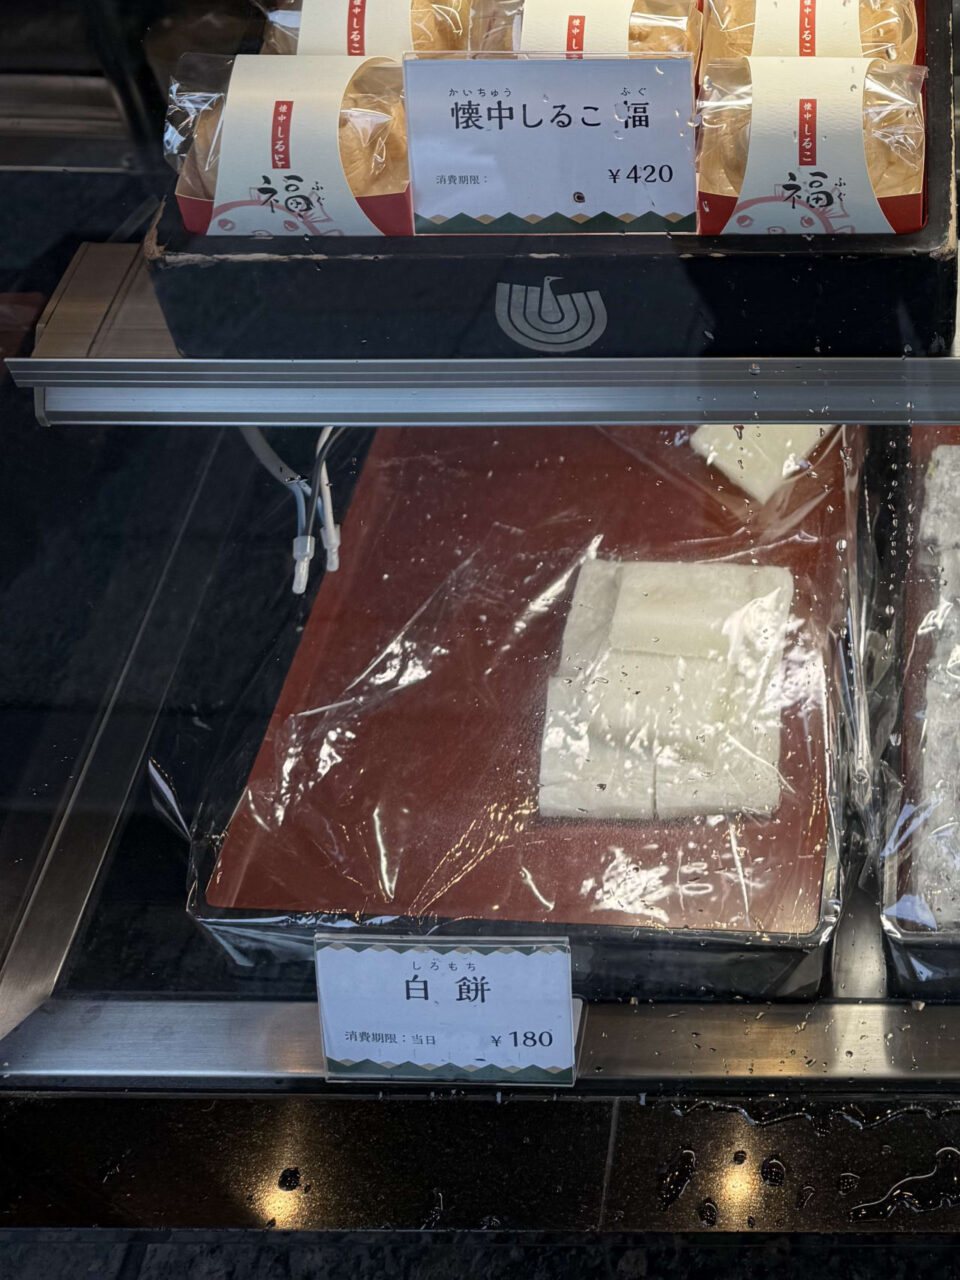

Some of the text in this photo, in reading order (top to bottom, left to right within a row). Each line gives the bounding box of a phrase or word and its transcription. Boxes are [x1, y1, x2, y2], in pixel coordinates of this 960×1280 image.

[449, 87, 512, 98] かいちゅう
[451, 100, 602, 130] 懐中しるこ
[608, 164, 674, 184] ¥420
[782, 171, 834, 209] 福
[412, 960, 477, 972] しろもち
